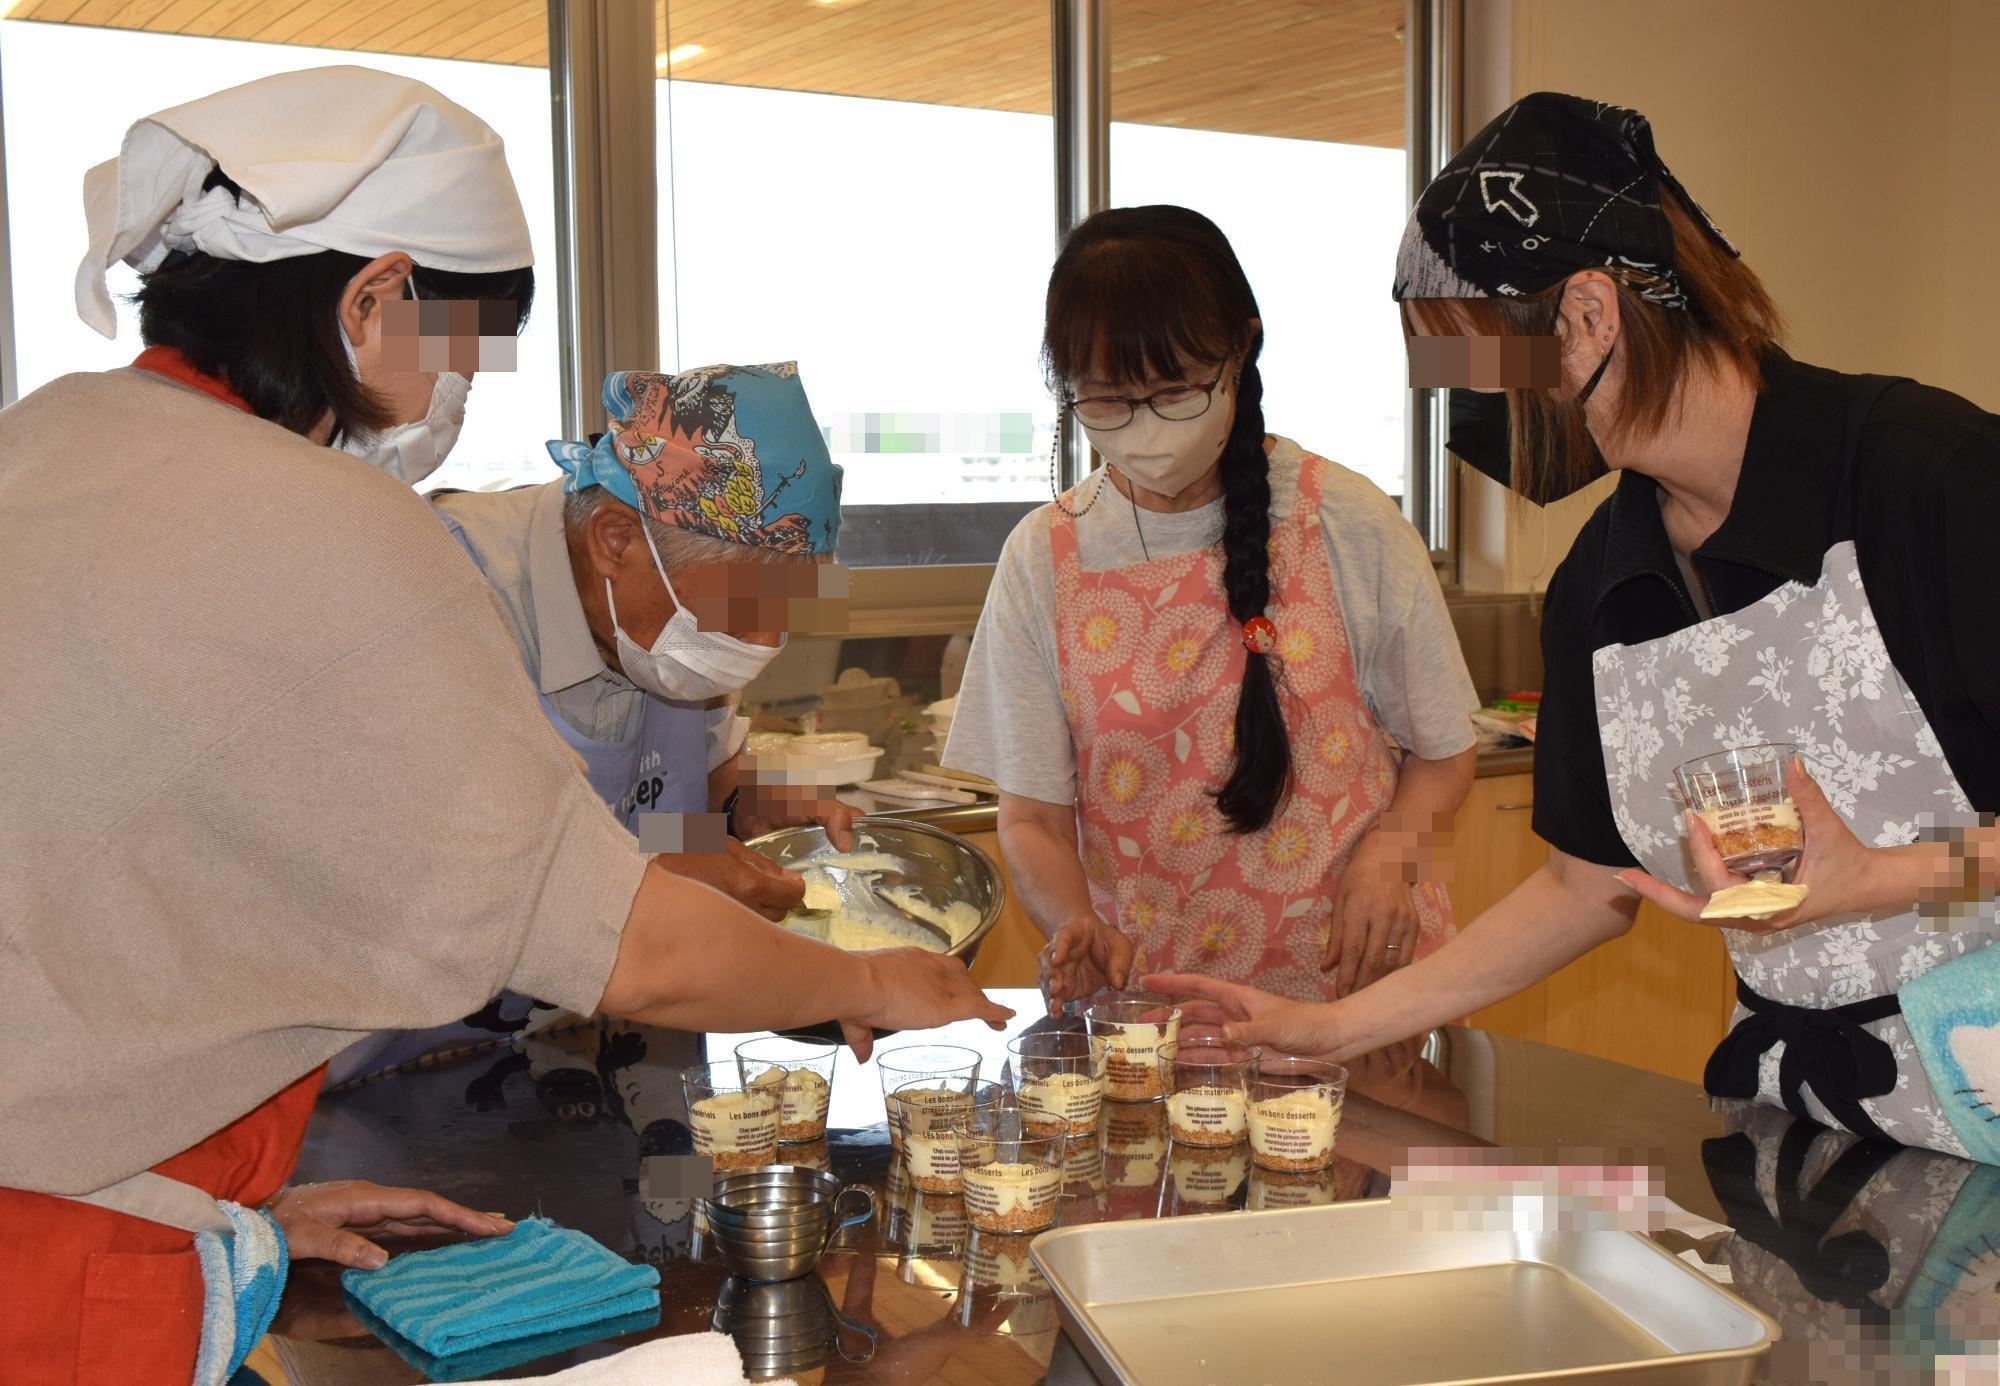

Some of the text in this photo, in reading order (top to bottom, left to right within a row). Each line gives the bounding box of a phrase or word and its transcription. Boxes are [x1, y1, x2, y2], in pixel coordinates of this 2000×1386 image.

[1126, 1046, 1153, 1054] desserts
[1062, 1080, 1074, 1088] Les
[924, 1095, 936, 1104] Les
[729, 1111, 742, 1121] Les
[743, 1110, 760, 1120] bons
[1257, 1107, 1316, 1120] Les bons desserts
[923, 1130, 935, 1139] Les
[936, 1132, 954, 1140] bons
[1021, 1168, 1033, 1177] Les
